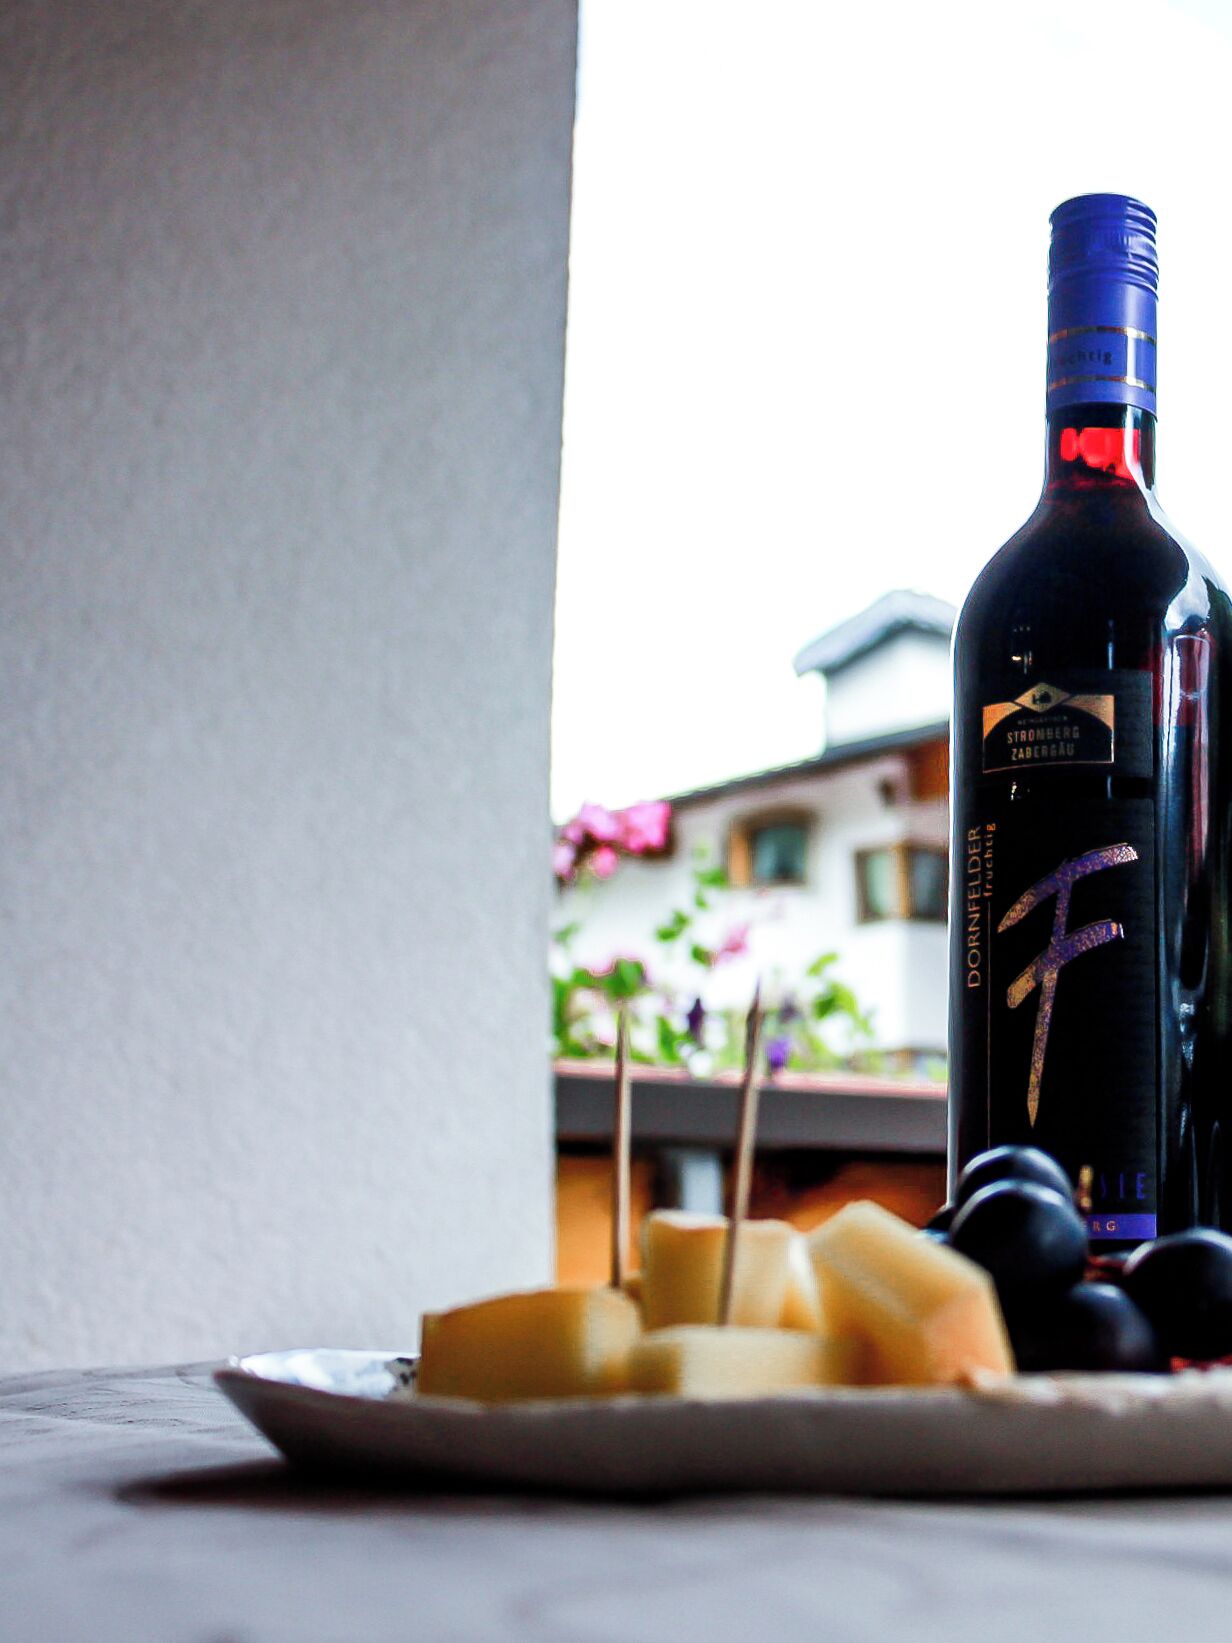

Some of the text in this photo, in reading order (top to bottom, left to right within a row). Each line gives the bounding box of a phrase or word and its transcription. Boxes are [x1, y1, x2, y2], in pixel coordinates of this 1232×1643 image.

[1006, 725, 1081, 745] STROMBERG
[1010, 740, 1075, 762] ZABERGÄU
[967, 825, 982, 988] DORNFELDER
